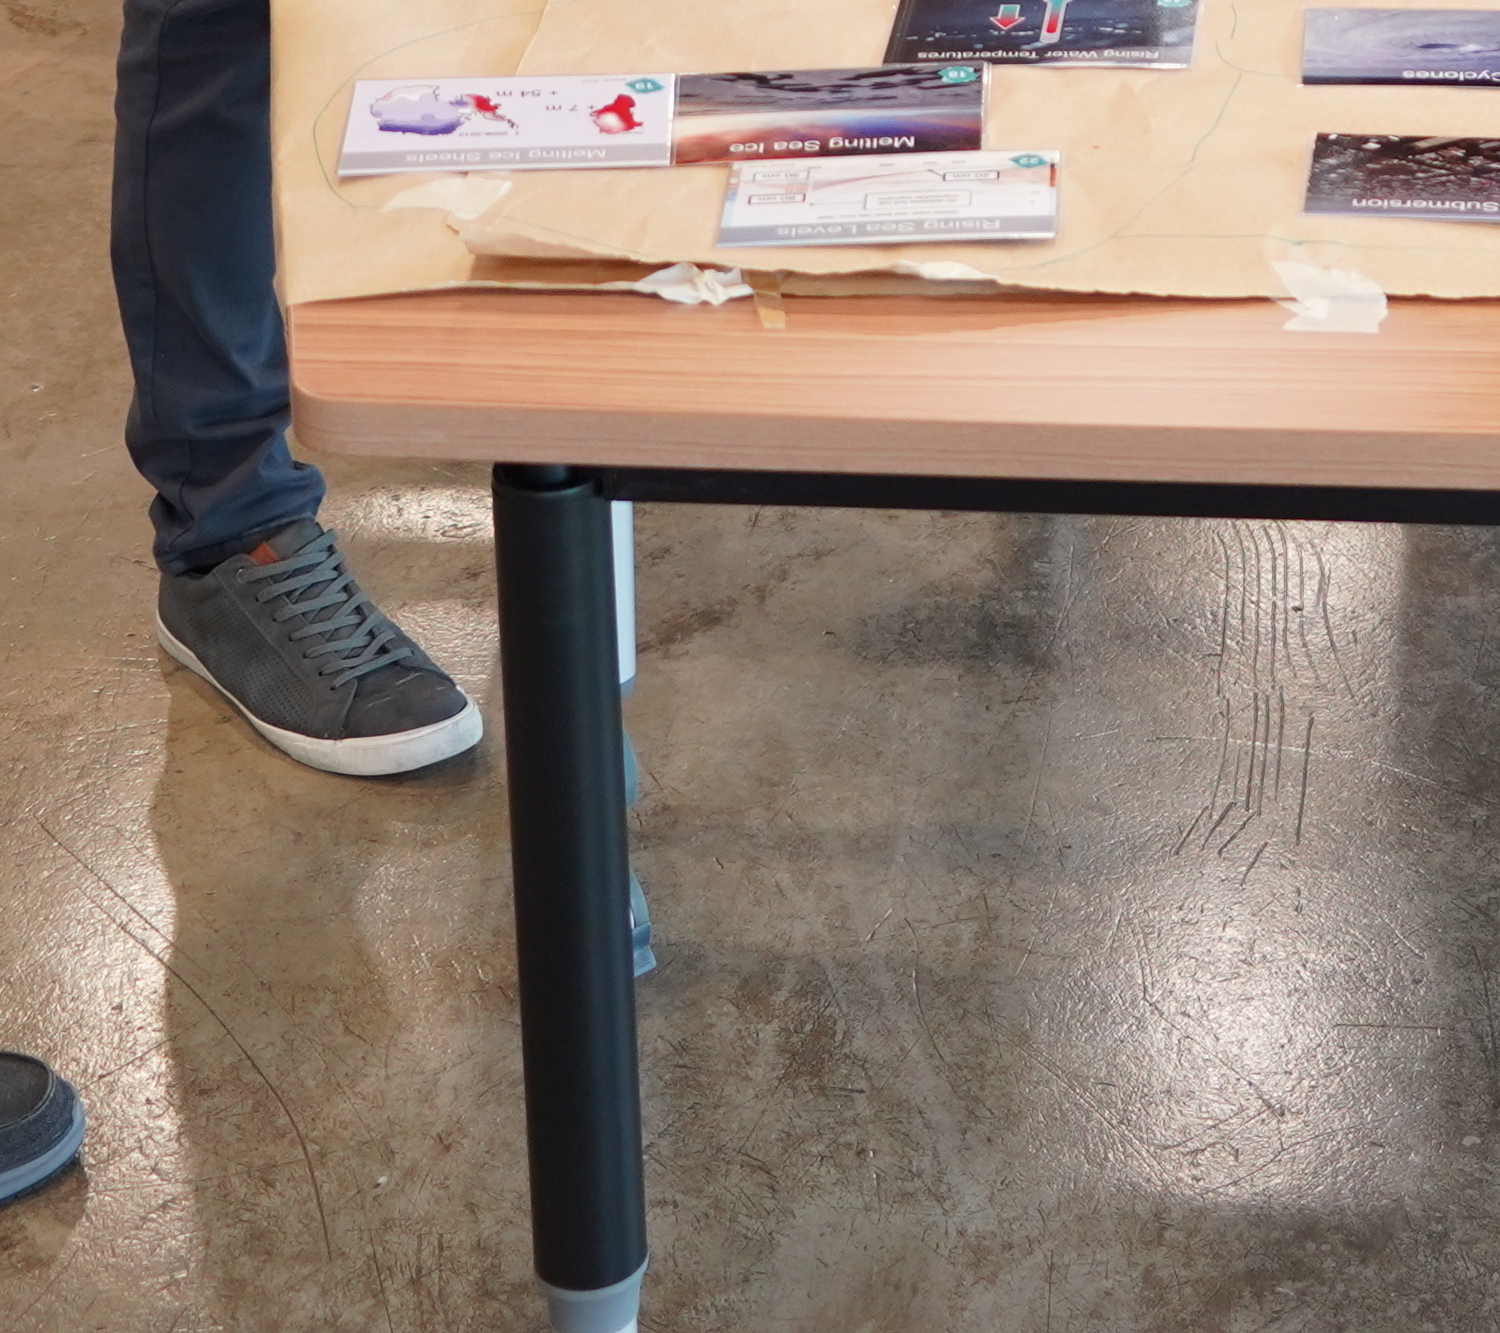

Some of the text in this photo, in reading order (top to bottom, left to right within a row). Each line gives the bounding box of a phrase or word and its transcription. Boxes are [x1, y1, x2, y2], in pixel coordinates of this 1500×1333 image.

[917, 48, 1159, 60] Rising Water Temperatures
[729, 135, 915, 154] Melting Sea Ice
[406, 148, 606, 163] Melting Ice Sheets
[1352, 198, 1500, 212] Submersion
[776, 217, 1001, 237] Rising Sea Levels
